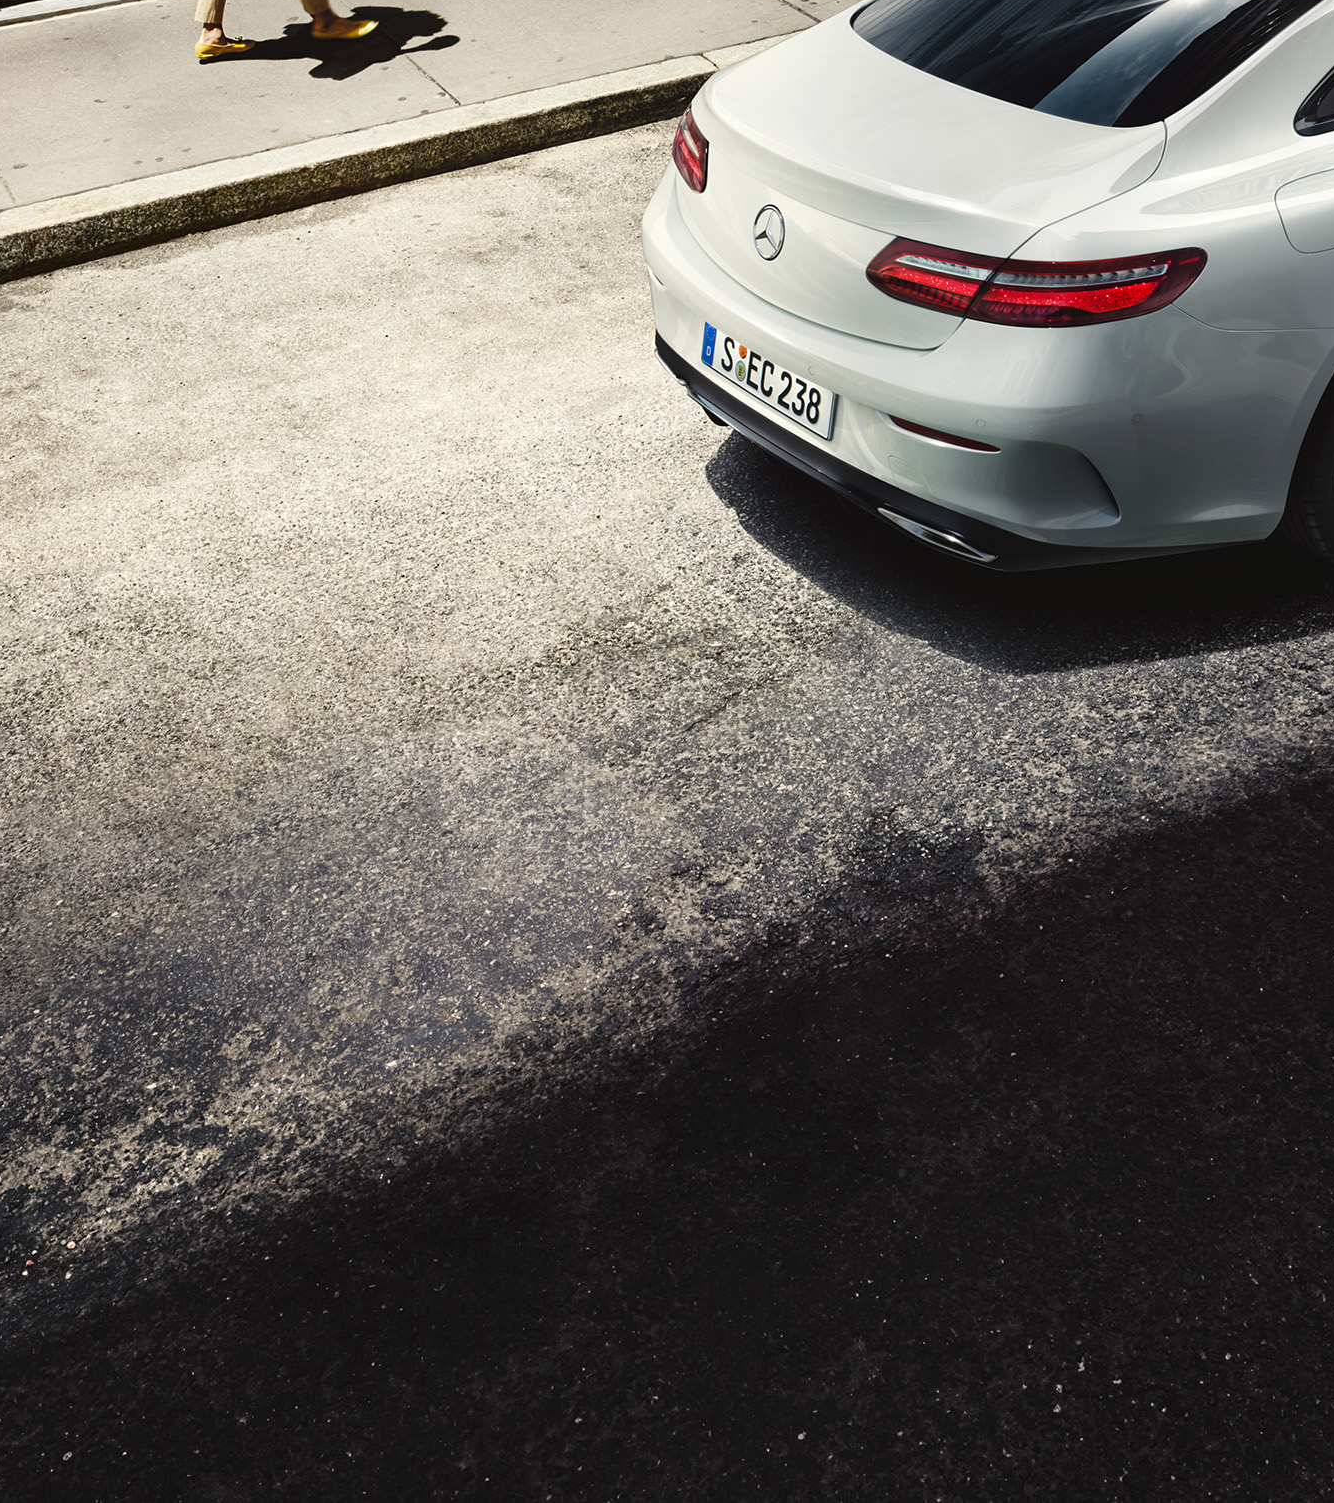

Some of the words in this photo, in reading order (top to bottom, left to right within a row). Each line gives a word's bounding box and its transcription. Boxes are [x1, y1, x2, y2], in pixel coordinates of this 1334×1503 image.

[706, 345, 711, 357] D
[721, 336, 735, 372] S
[746, 350, 775, 397] EC
[777, 371, 821, 424] 238
